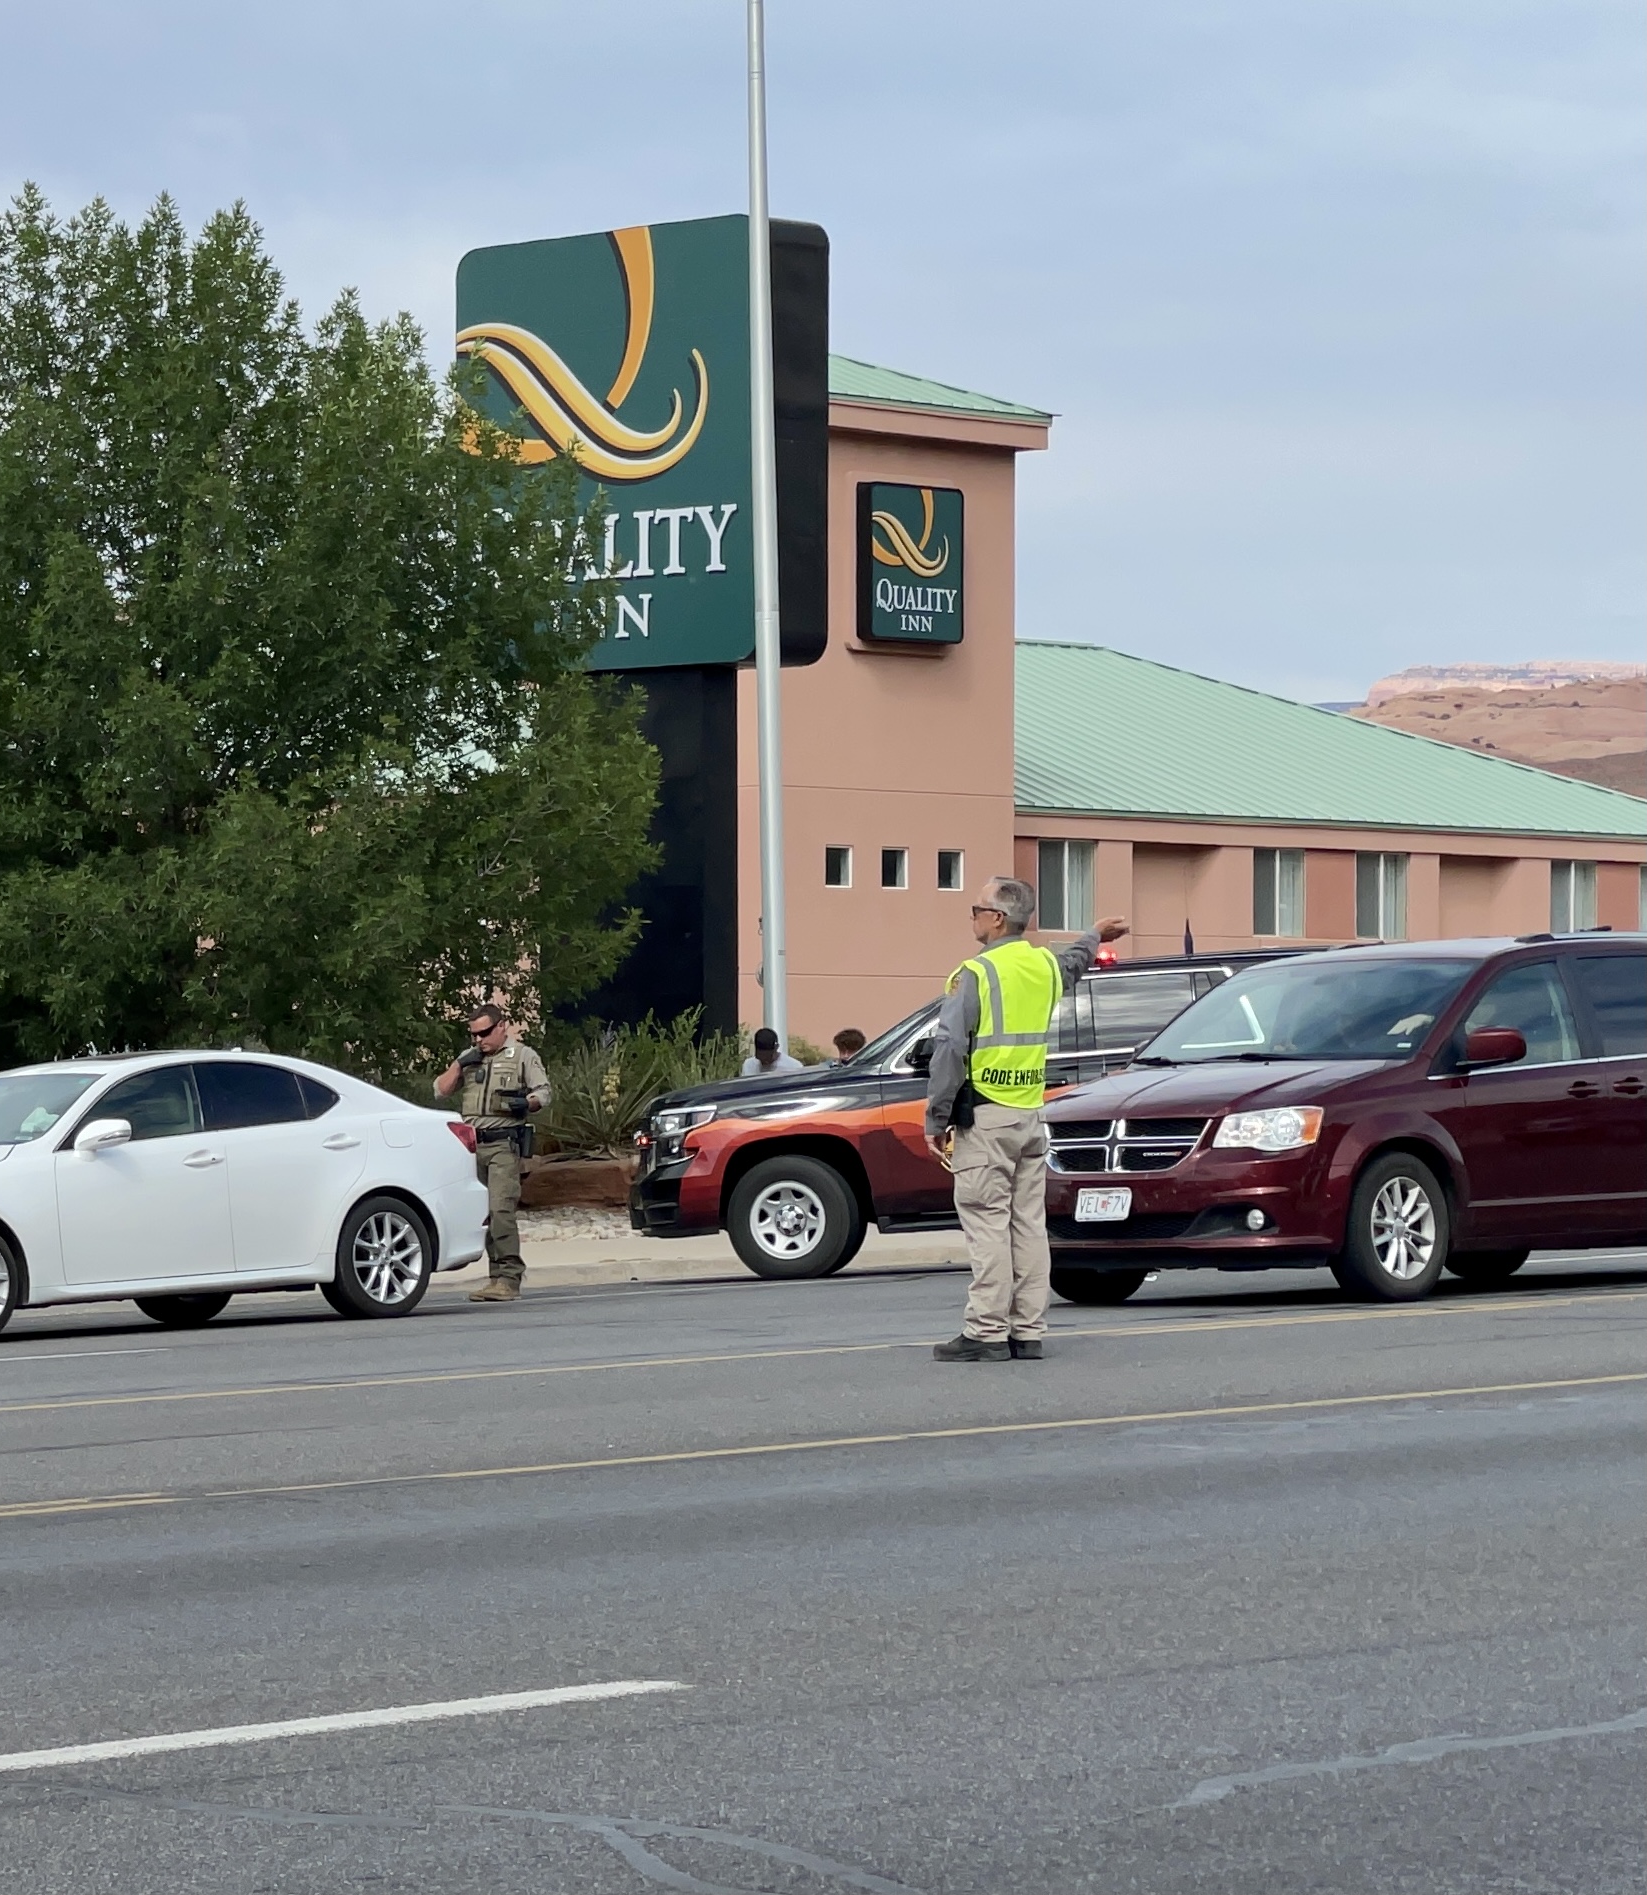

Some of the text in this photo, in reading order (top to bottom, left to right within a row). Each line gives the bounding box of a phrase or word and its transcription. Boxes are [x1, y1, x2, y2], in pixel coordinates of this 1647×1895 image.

[876, 578, 958, 613] QUALITY
[900, 614, 933, 632] INN
[981, 1067, 1013, 1086] CODE
